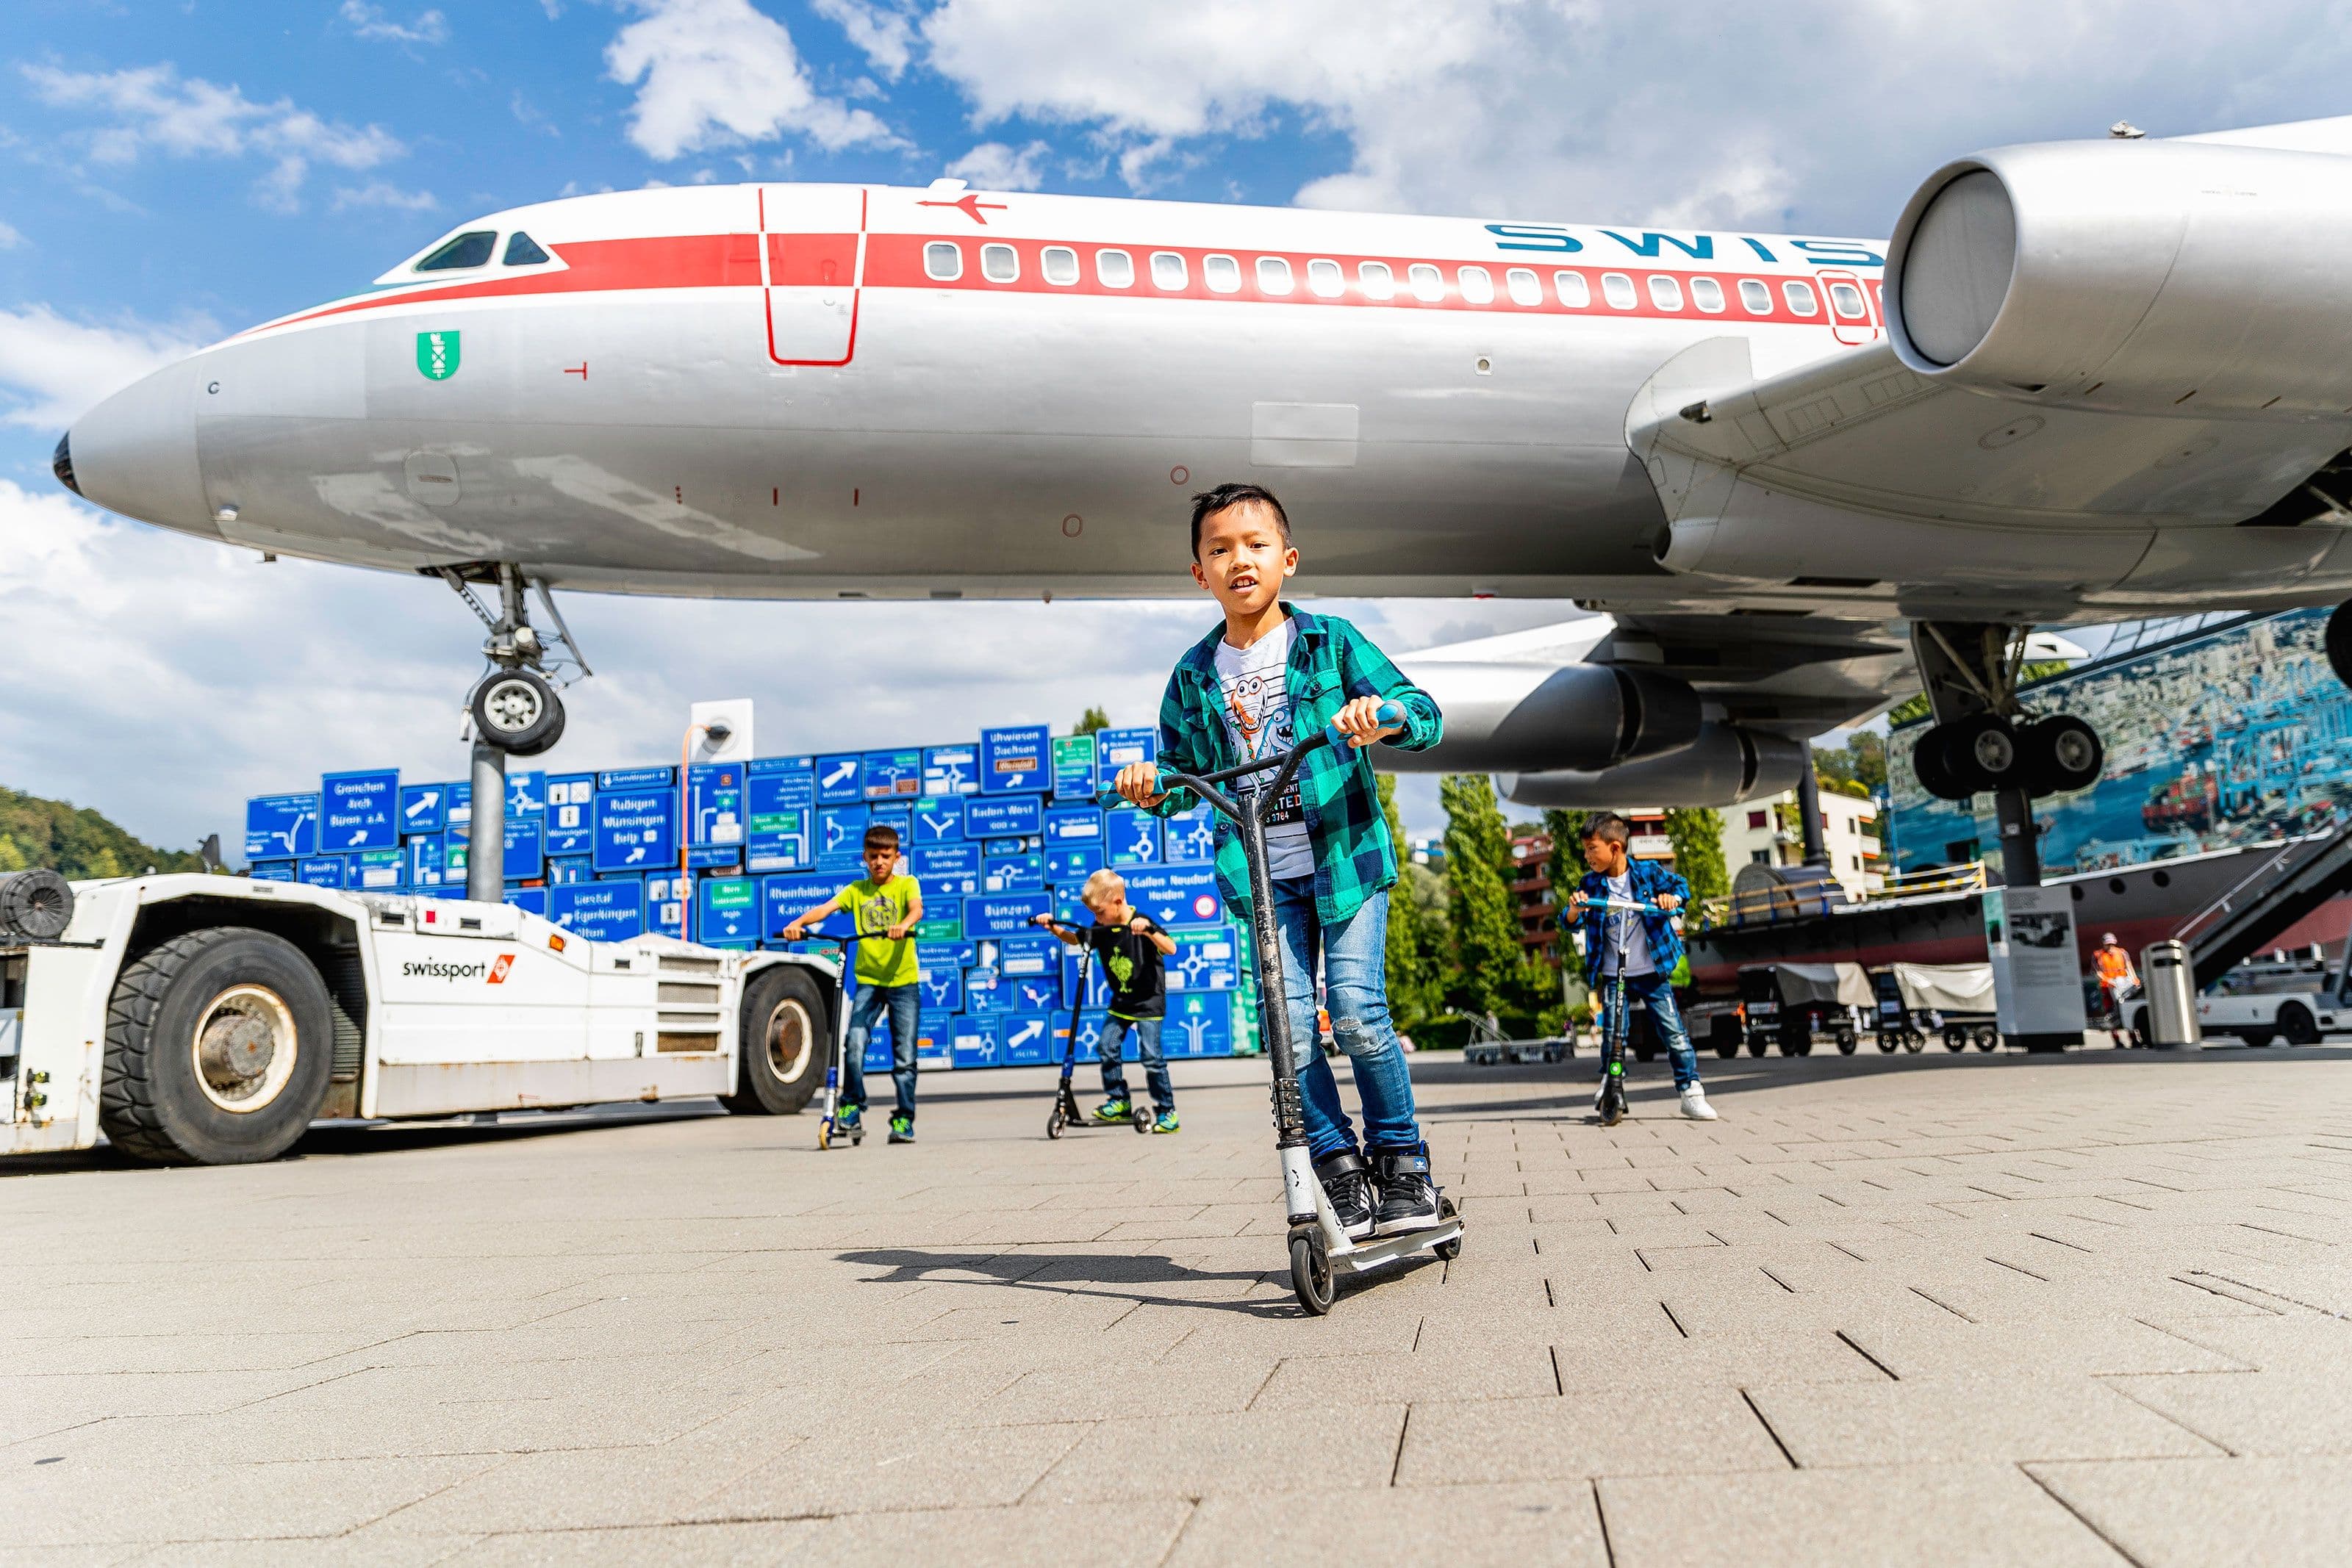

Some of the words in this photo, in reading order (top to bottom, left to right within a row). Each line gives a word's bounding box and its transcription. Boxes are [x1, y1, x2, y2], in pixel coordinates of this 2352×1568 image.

[1485, 224, 1885, 267] SWIS
[994, 745, 1036, 757] Dachsen
[334, 782, 386, 796] Grenchen
[348, 798, 373, 810] Arch
[610, 798, 657, 812] Rubigen
[602, 815, 666, 828] Münsingen
[613, 832, 639, 845] Belp
[1169, 871, 1213, 885] Neudorf
[574, 891, 613, 906] Liestal
[1148, 891, 1185, 902] Heiden
[574, 907, 637, 923] Egerkingen
[990, 920, 1014, 931] 1000
[404, 957, 485, 982] swissport
